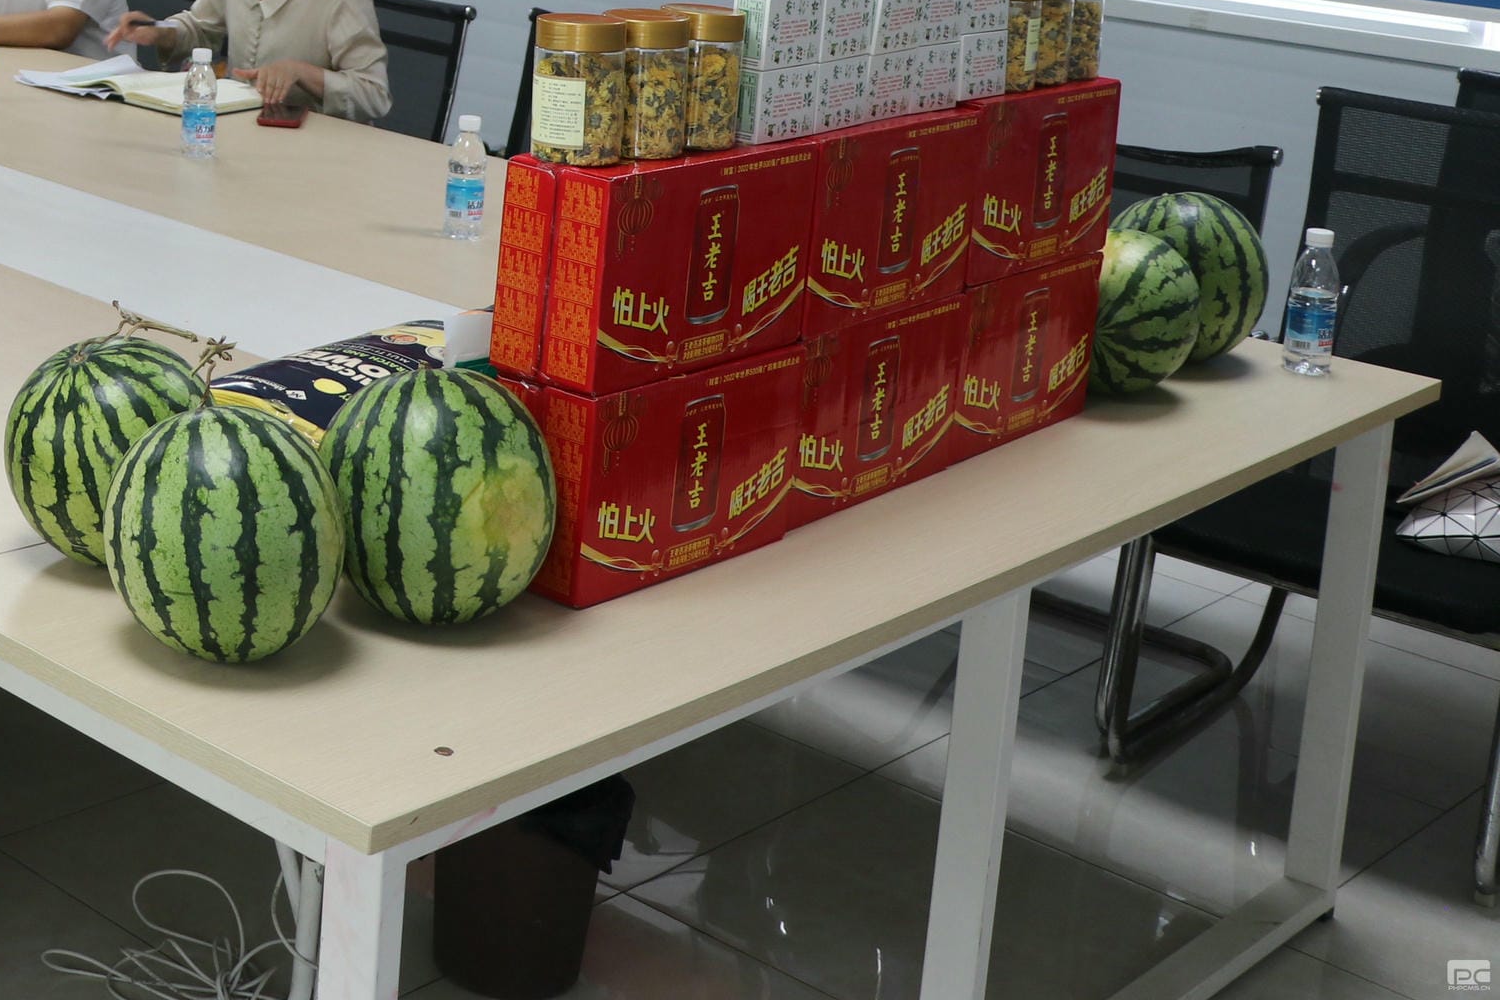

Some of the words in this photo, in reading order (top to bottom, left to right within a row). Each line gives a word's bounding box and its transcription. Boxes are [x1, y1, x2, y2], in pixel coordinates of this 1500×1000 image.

[890, 172, 907, 252] 王老吉
[1044, 136, 1057, 209] 王老吉
[821, 238, 865, 283] 怕上火
[920, 202, 967, 266] 喝王老吉
[983, 193, 1022, 236] 怕上火
[612, 286, 669, 335] 怕上火
[742, 245, 799, 316] 喝王老吉
[702, 213, 723, 301] 王老吉
[1023, 311, 1037, 383] 王老吉
[799, 433, 844, 473] 怕上火
[902, 383, 950, 450] 喝王老吉
[870, 361, 887, 440] 王老吉
[964, 374, 1001, 411] 怕上火
[598, 501, 656, 544] 怕上火
[728, 446, 788, 520] 喝王老吉
[689, 423, 708, 508] 王老吉
